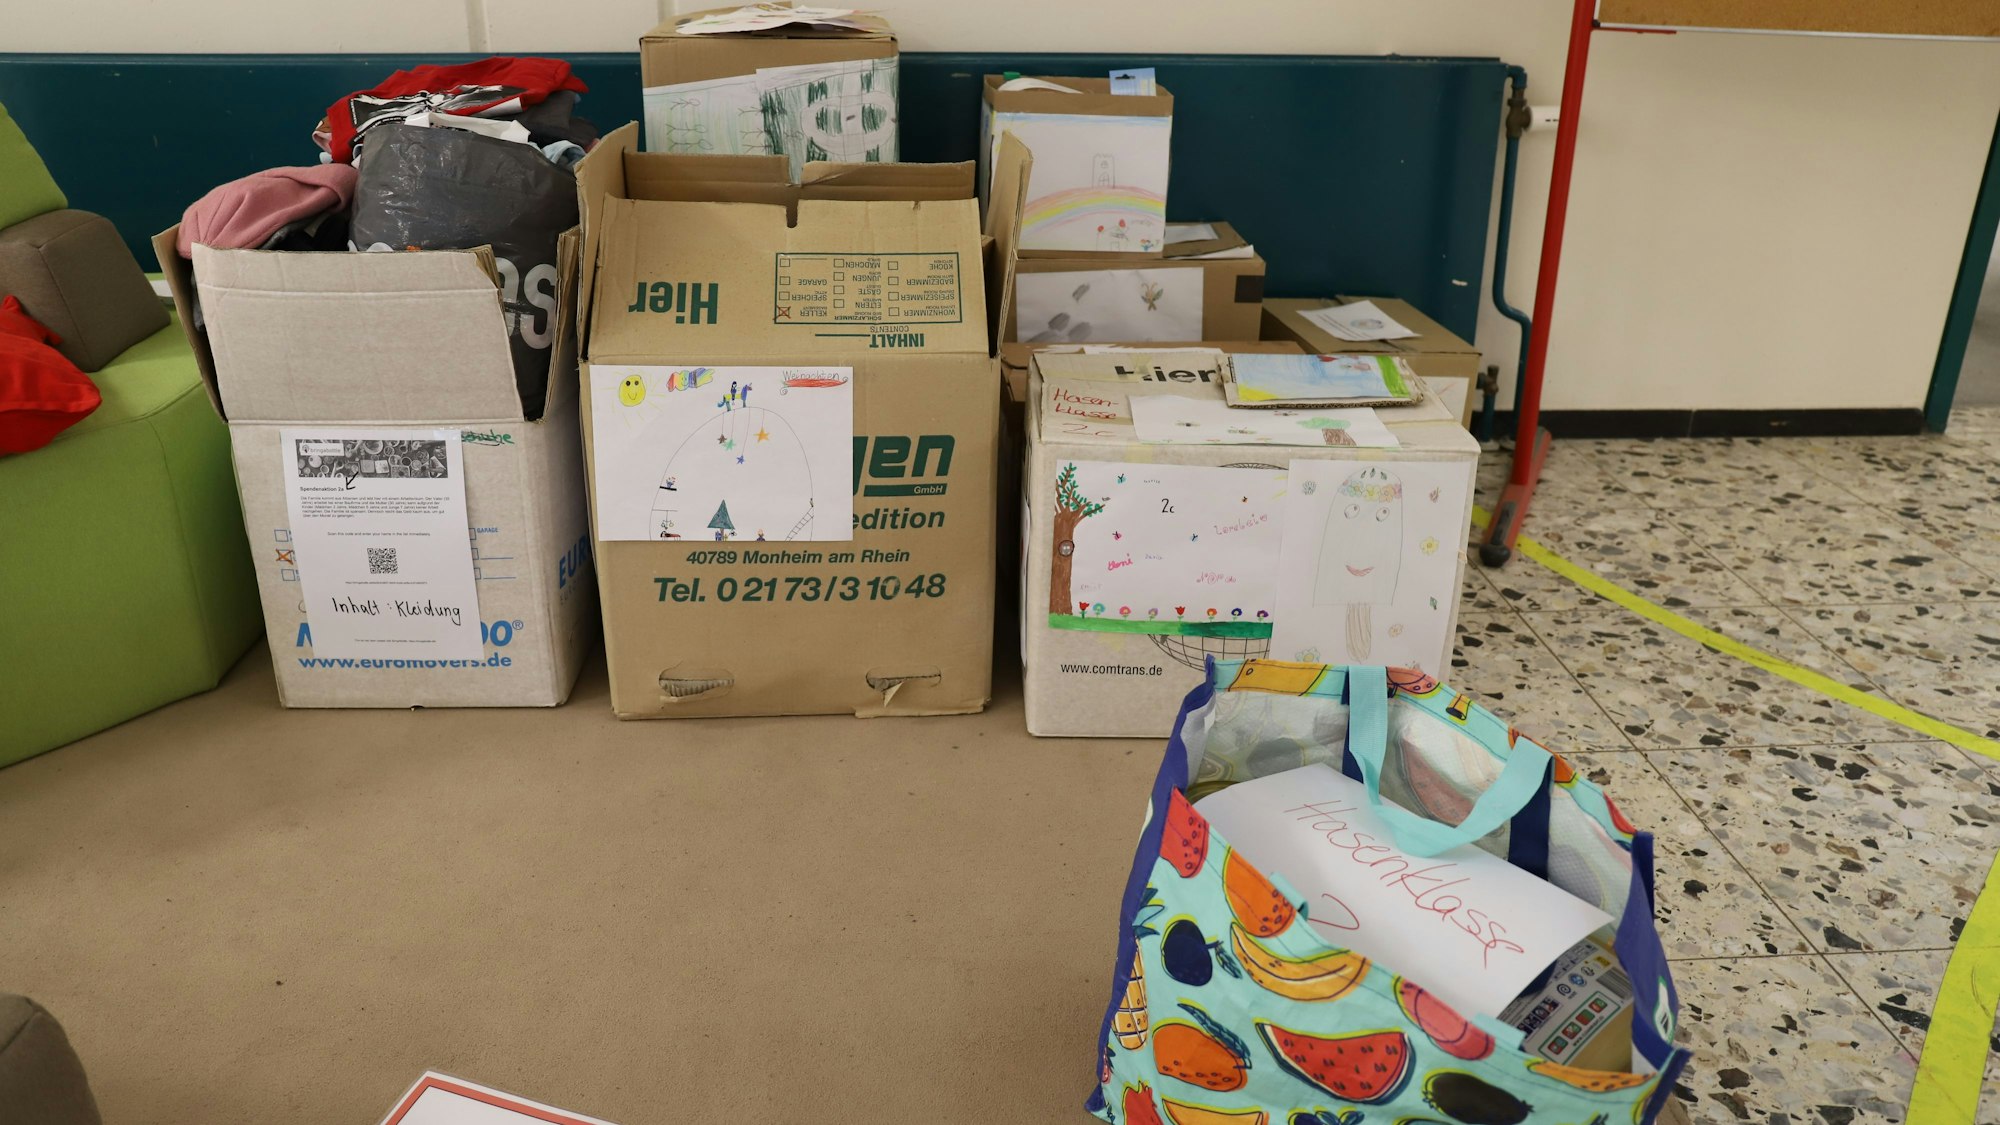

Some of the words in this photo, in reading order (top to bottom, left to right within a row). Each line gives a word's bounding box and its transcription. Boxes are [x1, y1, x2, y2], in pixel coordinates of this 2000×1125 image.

[628, 281, 719, 325] Hier
[869, 333, 925, 348] INHALT
[782, 370, 840, 380] Weinachten
[1054, 388, 1120, 407] Hasen-
[913, 483, 944, 495] GmbH
[1161, 498, 1175, 514] 2c
[686, 550, 738, 564] 40789
[742, 550, 822, 564] Monheim
[828, 552, 856, 564] am
[860, 549, 911, 564] Rhein
[654, 577, 706, 602] Tel.
[332, 596, 380, 616] Inhalt
[394, 600, 462, 626] Kleidung
[298, 652, 512, 669] www.euromovers.de
[1060, 664, 1163, 676] www.comtrans.de
